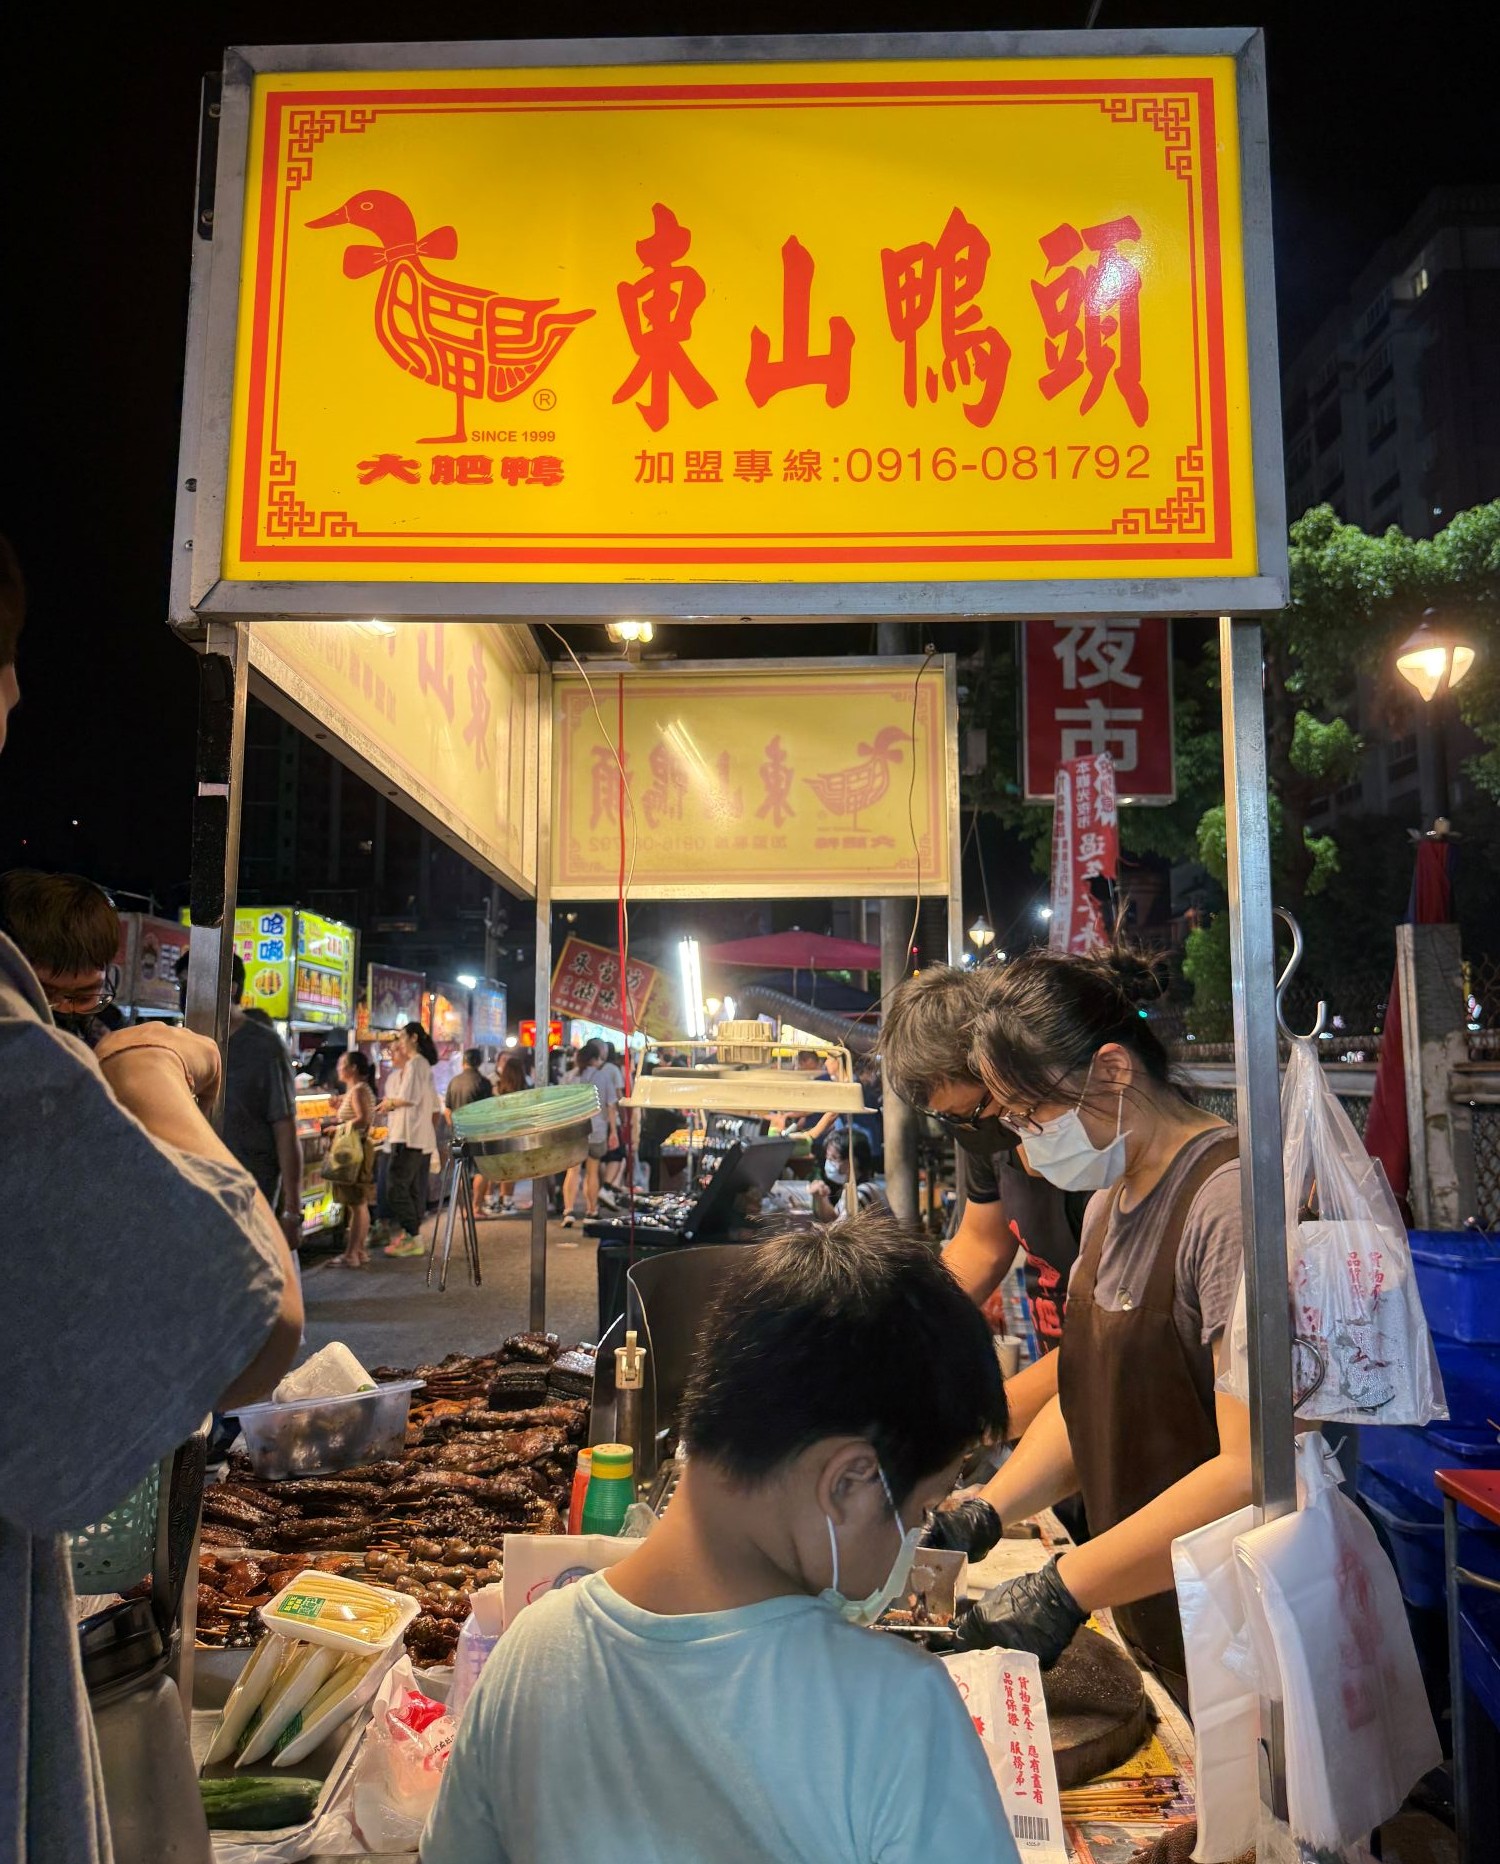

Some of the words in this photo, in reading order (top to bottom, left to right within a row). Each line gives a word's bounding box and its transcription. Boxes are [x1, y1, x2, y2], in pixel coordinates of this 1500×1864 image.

[612, 202, 1149, 433] 東山鴨頭
[356, 453, 566, 487] 大肥鴨
[471, 430, 517, 443] SINCE
[521, 430, 556, 443] 1999
[1053, 617, 1143, 771] 夜市
